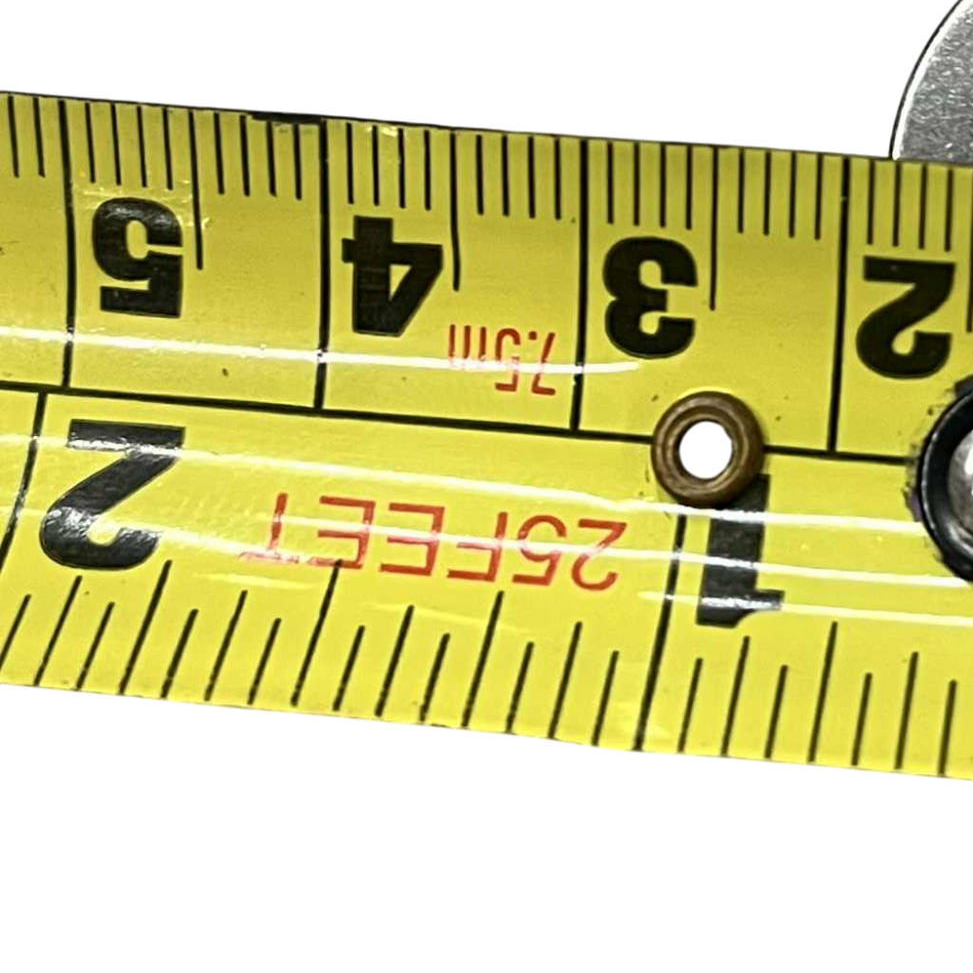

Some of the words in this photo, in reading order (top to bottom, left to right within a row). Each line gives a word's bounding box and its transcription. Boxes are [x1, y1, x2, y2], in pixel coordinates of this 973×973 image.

[91, 197, 183, 318] 5
[341, 215, 444, 338] 4
[602, 235, 698, 359] 3
[855, 255, 957, 380] 2
[448, 323, 556, 395] 7.5m
[39, 418, 186, 570] 2
[238, 493, 628, 591] 25FEET
[695, 472, 785, 629] 1
